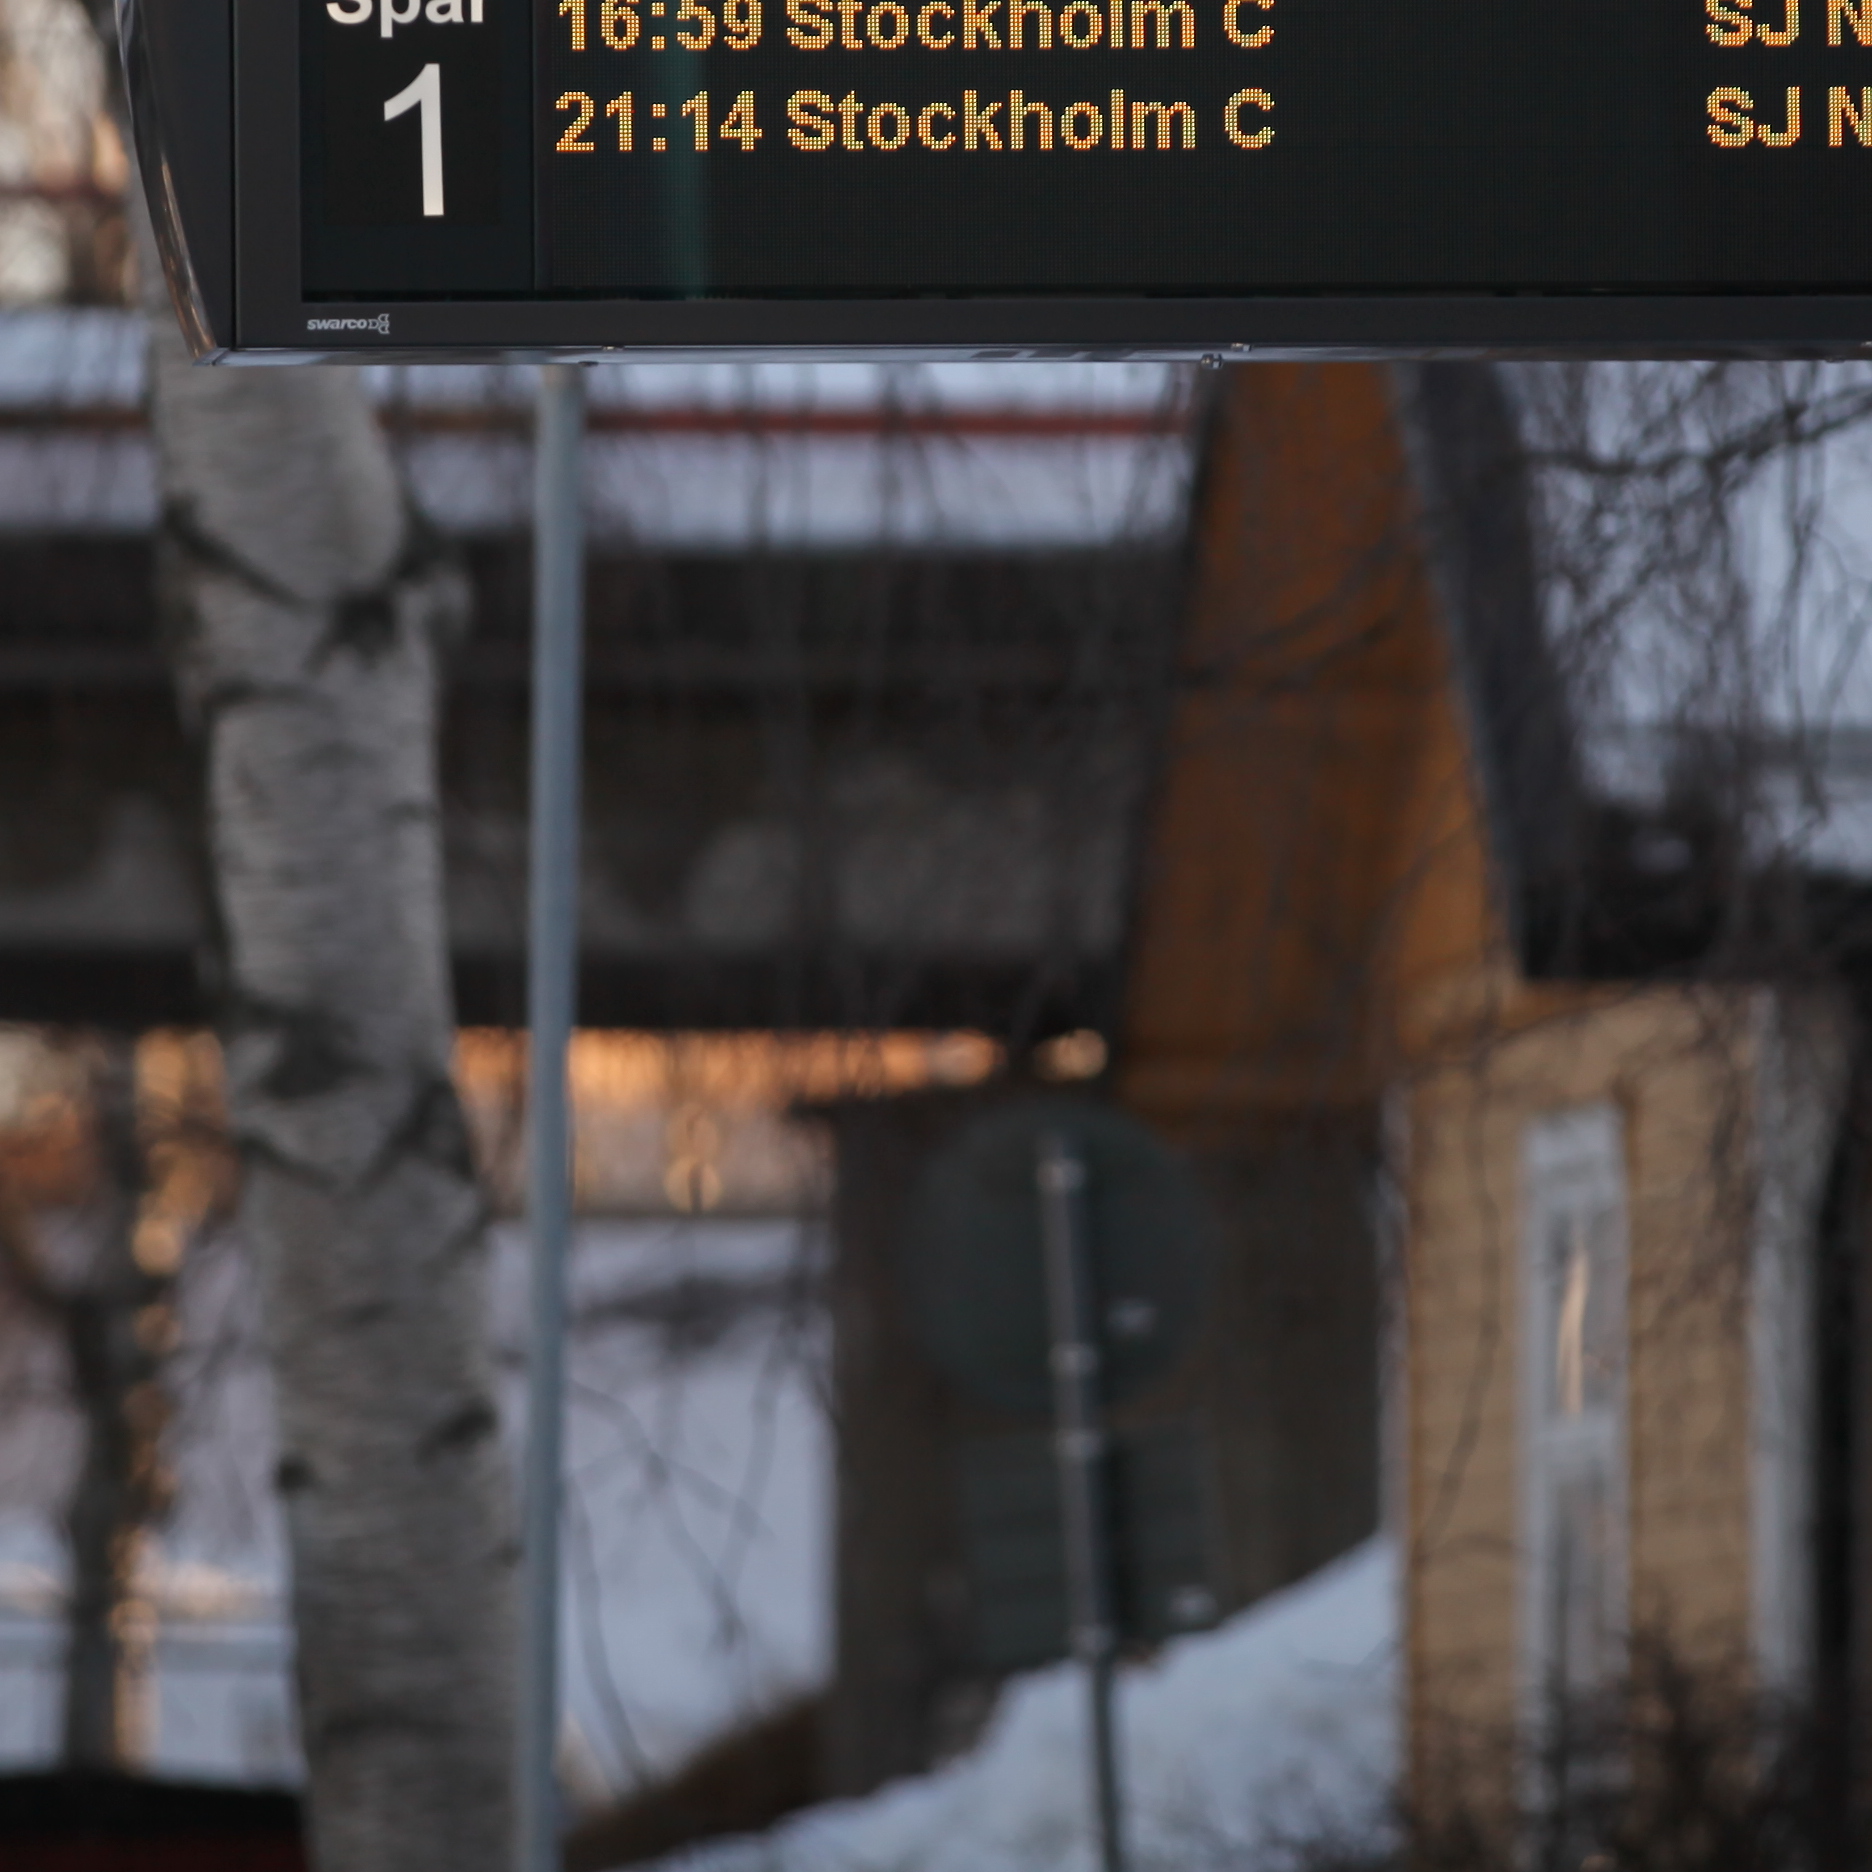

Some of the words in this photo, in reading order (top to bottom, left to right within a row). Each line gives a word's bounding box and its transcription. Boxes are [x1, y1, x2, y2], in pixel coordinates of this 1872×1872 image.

[383, 63, 445, 217] 1
[555, 90, 763, 153] 21:14
[786, 88, 1196, 152] Stockholm
[1224, 88, 1275, 150] C
[1706, 86, 1801, 148] SJ
[307, 318, 368, 330] swarco
